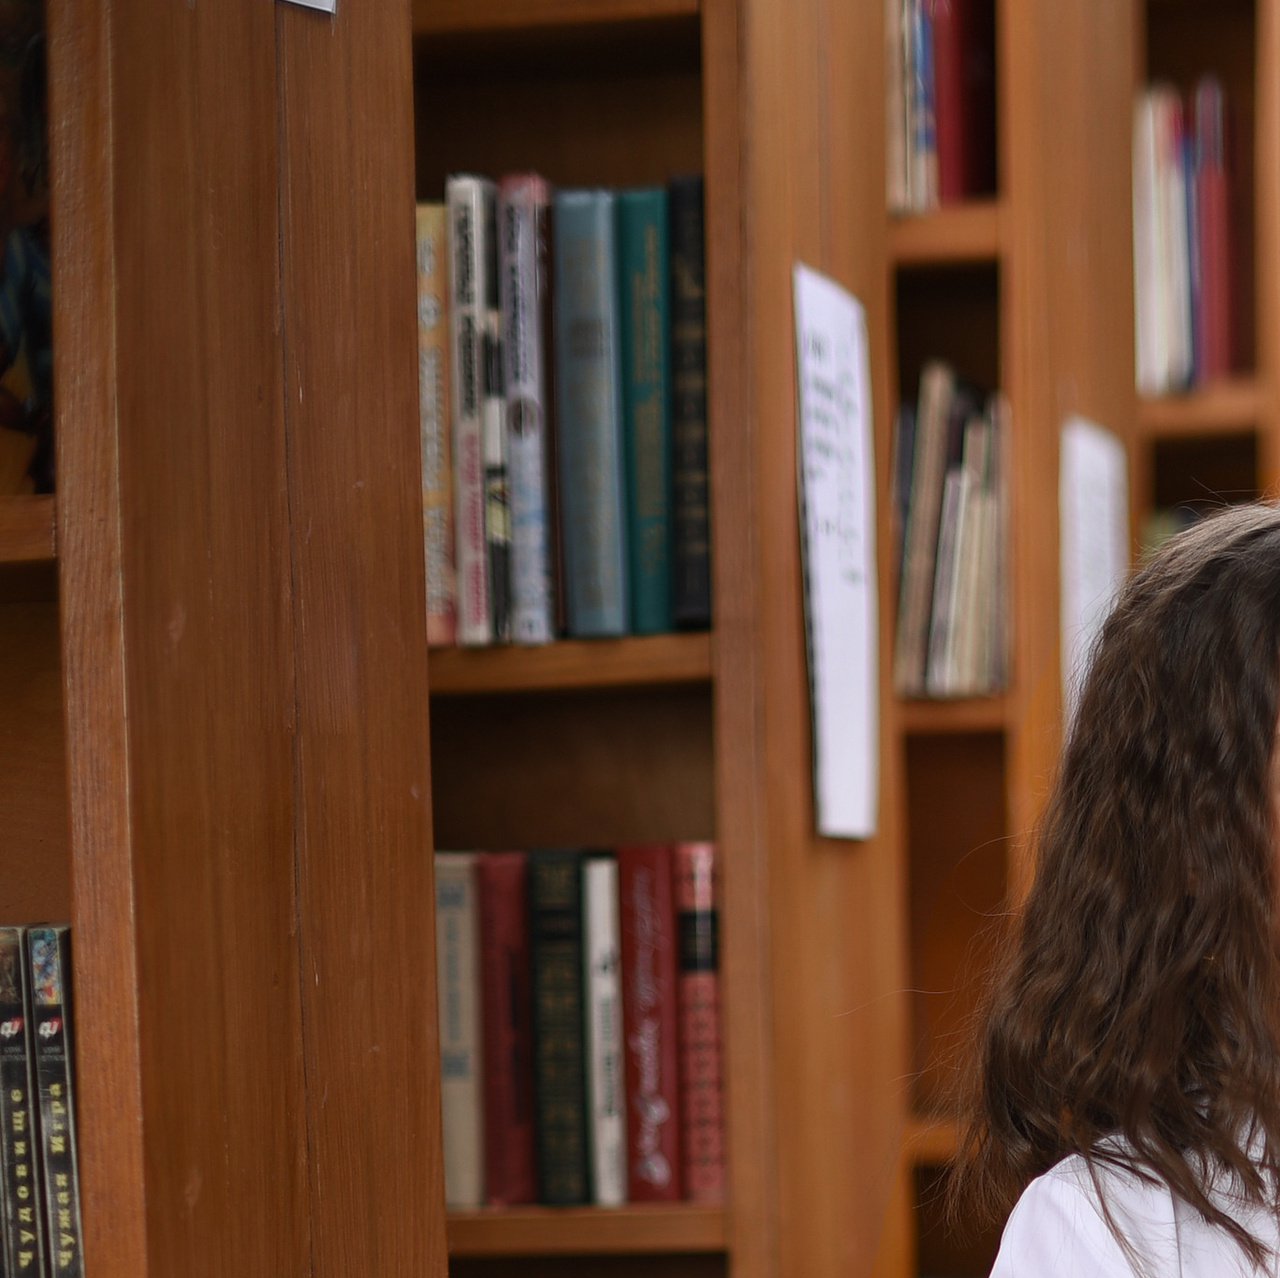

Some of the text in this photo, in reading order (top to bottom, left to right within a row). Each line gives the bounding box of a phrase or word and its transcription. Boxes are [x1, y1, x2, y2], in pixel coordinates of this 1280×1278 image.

[50, 1083, 66, 1153] Игра
[11, 1089, 35, 1268] Чудовище
[55, 1173, 76, 1268] Чужая
